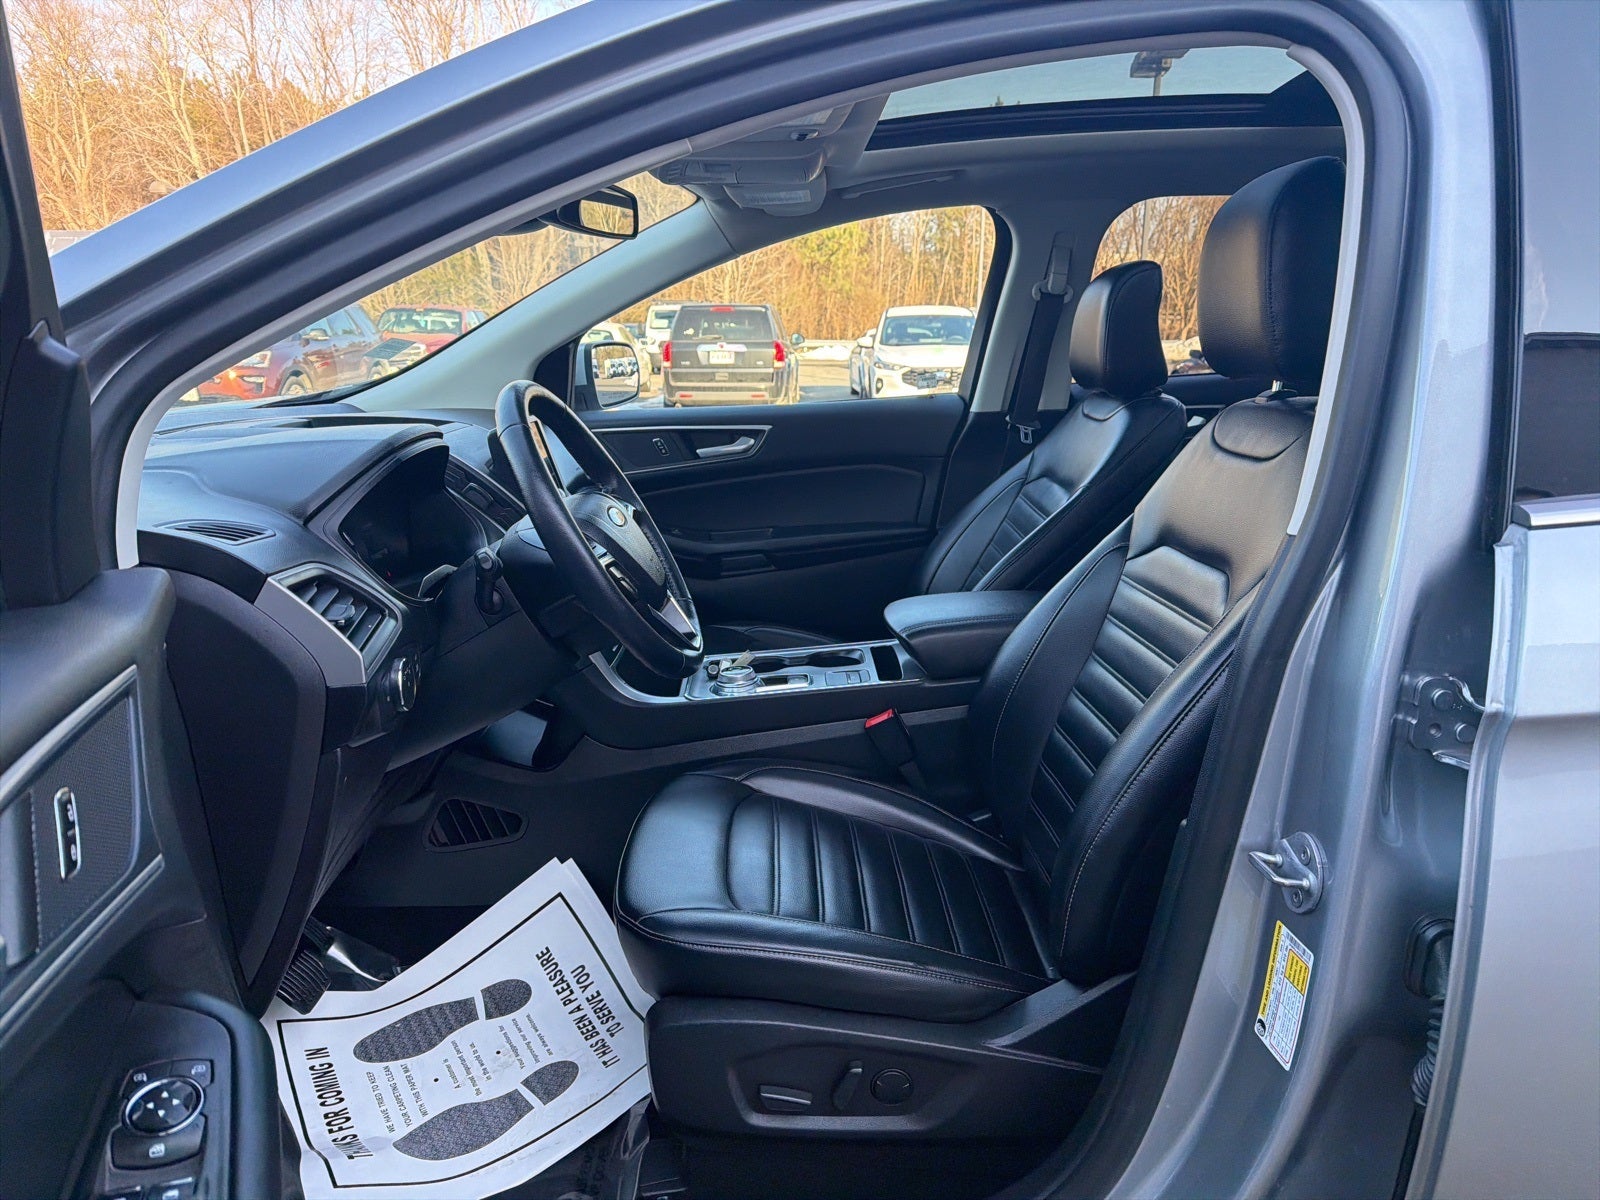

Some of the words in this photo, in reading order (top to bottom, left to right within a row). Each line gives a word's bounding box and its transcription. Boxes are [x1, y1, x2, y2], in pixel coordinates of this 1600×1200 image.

[535, 946, 578, 1007] PLEASURE
[571, 964, 594, 994] YOU
[568, 1004, 584, 1015] A
[585, 990, 616, 1025] SERVE
[573, 1014, 600, 1041] BEEN
[606, 1022, 624, 1038] TO
[304, 1047, 330, 1060] IN
[590, 1039, 613, 1059] HAS
[400, 1064, 410, 1074] MAT
[602, 1055, 620, 1068] IT
[366, 1072, 377, 1084] KEEP
[382, 1065, 394, 1082] CLEAN
[309, 1062, 345, 1107] COMING
[405, 1074, 418, 1091] PAPER
[375, 1093, 386, 1108] TRIED
[390, 1082, 406, 1111] CARPETING
[413, 1091, 422, 1103] THIS
[380, 1108, 392, 1123] HAVE
[418, 1103, 429, 1117] WITH
[323, 1107, 354, 1134] FOR
[401, 1111, 412, 1127] YOUR
[386, 1123, 396, 1133] WE
